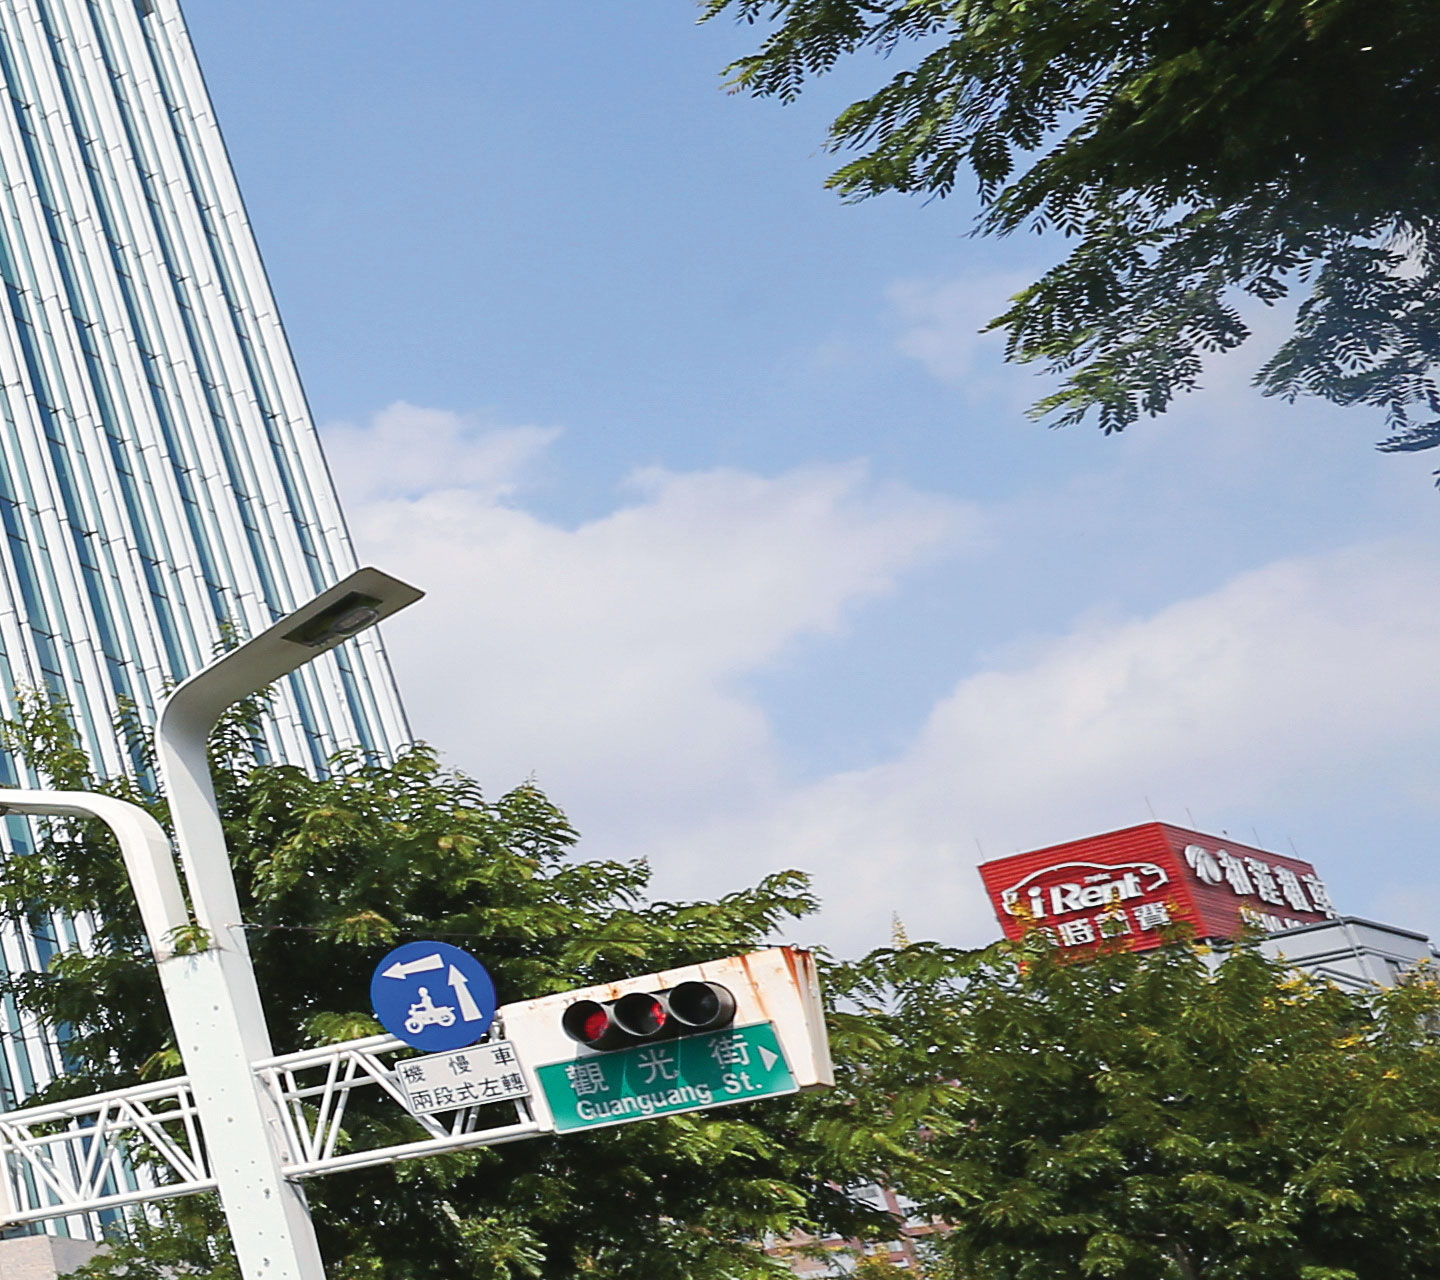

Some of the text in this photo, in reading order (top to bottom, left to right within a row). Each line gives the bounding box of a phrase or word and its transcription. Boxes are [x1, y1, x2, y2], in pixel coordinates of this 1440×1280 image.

[402, 1048, 515, 1083] 機慢車
[565, 1035, 750, 1096] 觀光街
[411, 1073, 525, 1110] 兩段式左轉
[576, 1071, 762, 1121] Guanguang St.
